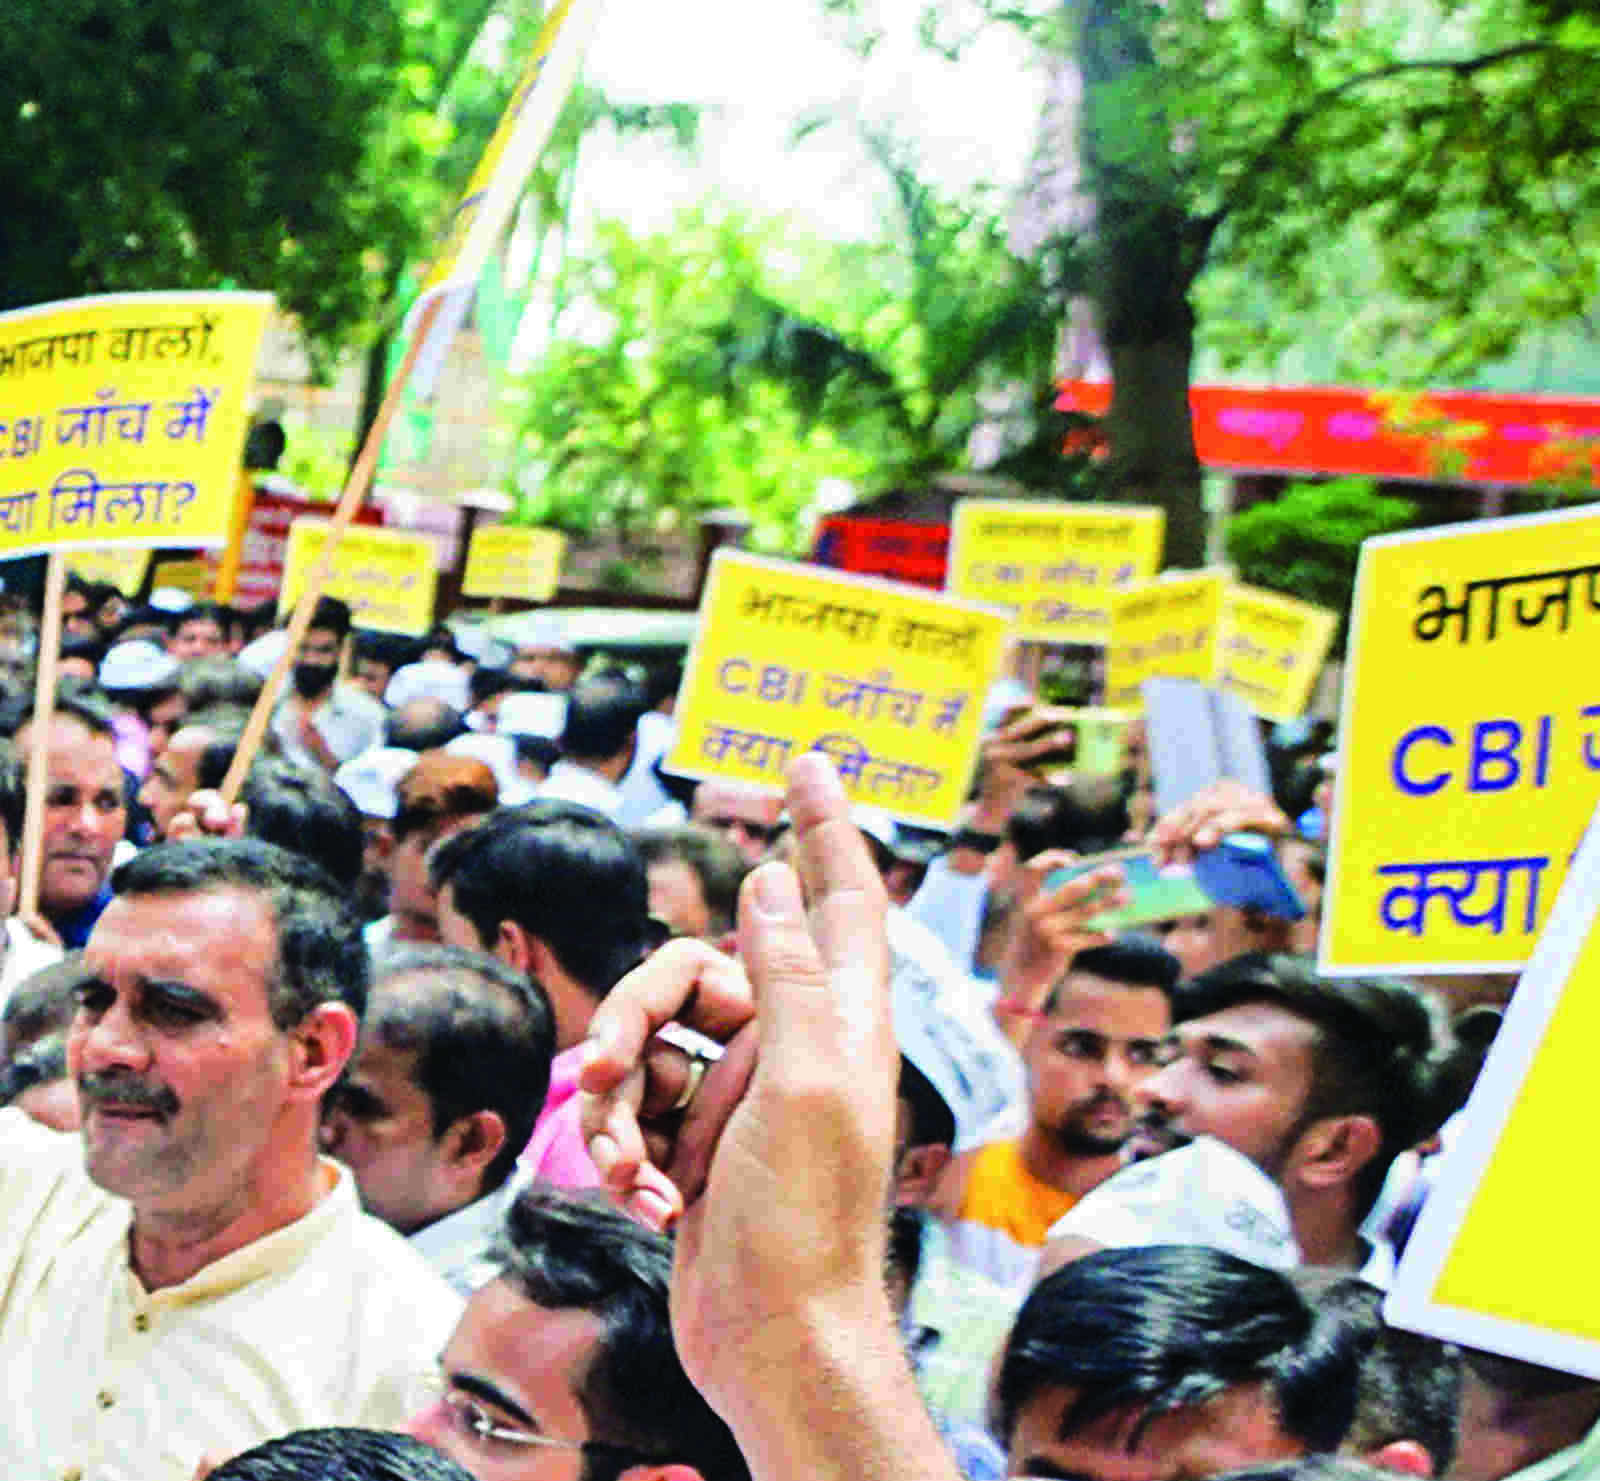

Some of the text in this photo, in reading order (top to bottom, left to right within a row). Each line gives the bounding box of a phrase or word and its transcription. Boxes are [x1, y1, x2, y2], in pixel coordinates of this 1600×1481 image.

[58, 388, 150, 447] जाँच
[166, 386, 220, 442] में
[47, 469, 196, 531] मिला?
[1414, 564, 1600, 644] भाज
[720, 659, 806, 703] CBI
[1391, 716, 1552, 797] CBI
[1377, 856, 1549, 935] क्या
